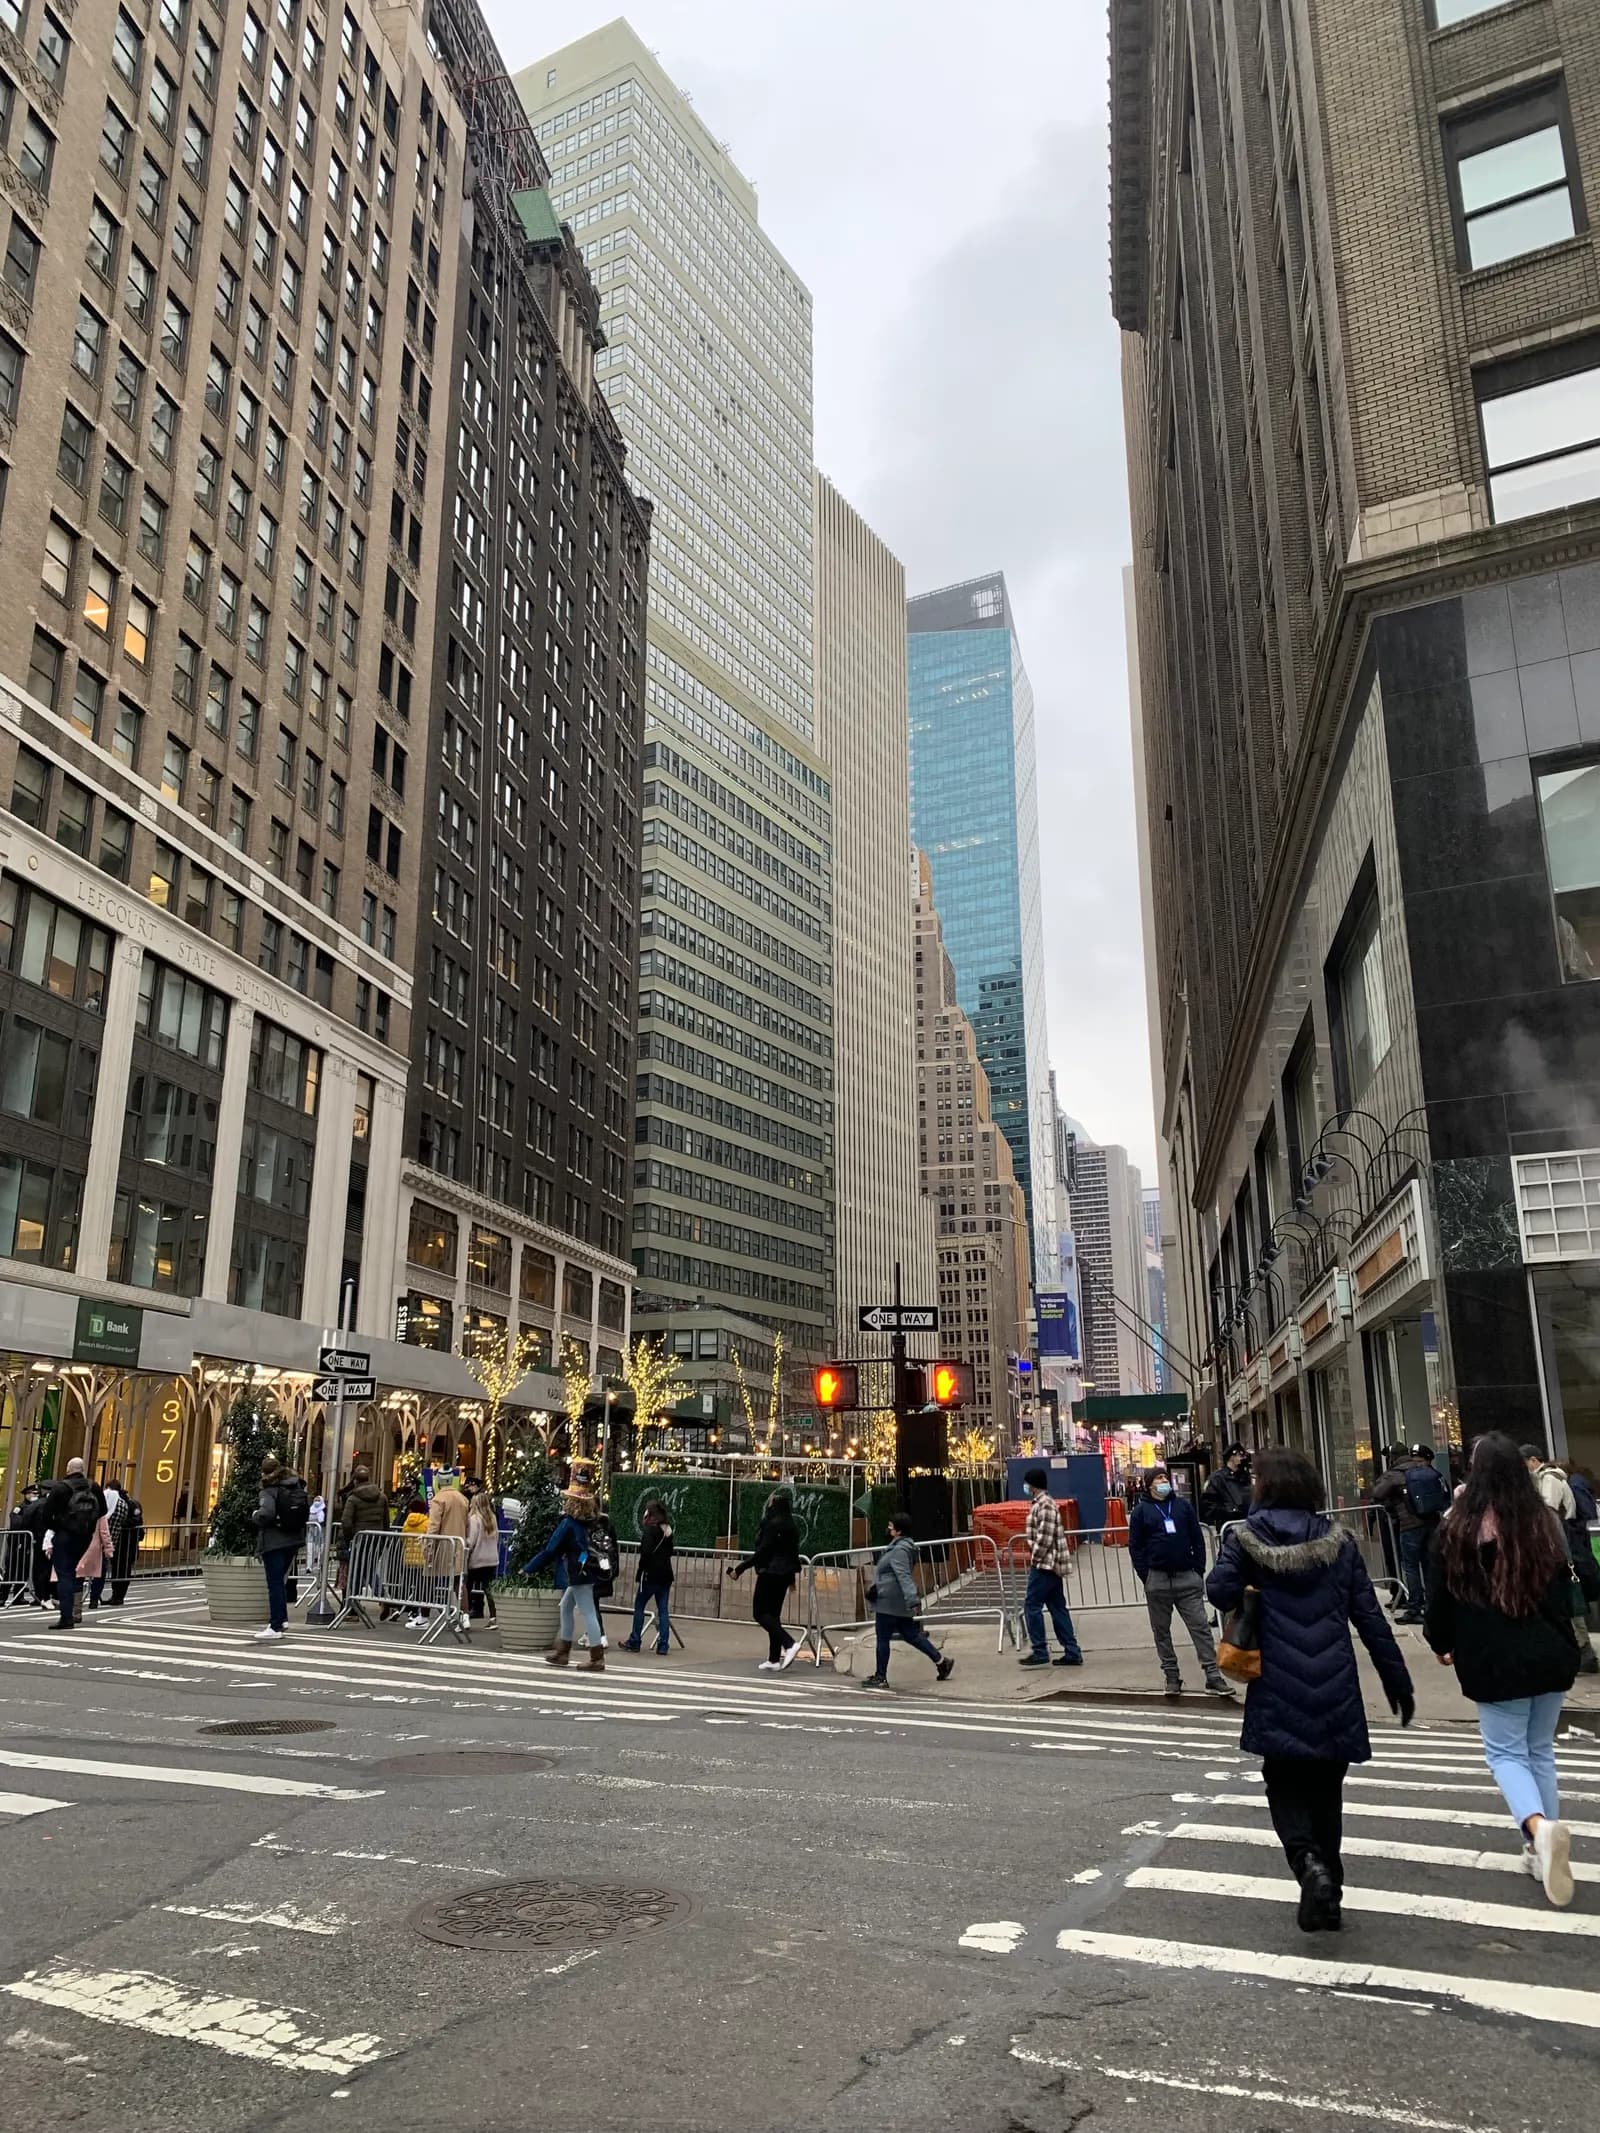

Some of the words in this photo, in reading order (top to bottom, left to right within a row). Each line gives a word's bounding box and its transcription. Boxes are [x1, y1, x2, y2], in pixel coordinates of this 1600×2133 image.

[77, 881, 157, 941] LEFCOURT
[177, 942, 216, 977] STATE
[234, 974, 289, 1018] BUILDING
[871, 1313, 894, 1324] ONE
[904, 1313, 928, 1324] WAY
[91, 1318, 104, 1333] TD
[106, 1321, 129, 1334] Bank
[328, 1355, 345, 1367] ONE
[350, 1358, 365, 1369] WAY
[321, 1384, 338, 1395] ONE
[347, 1384, 368, 1394] WAY
